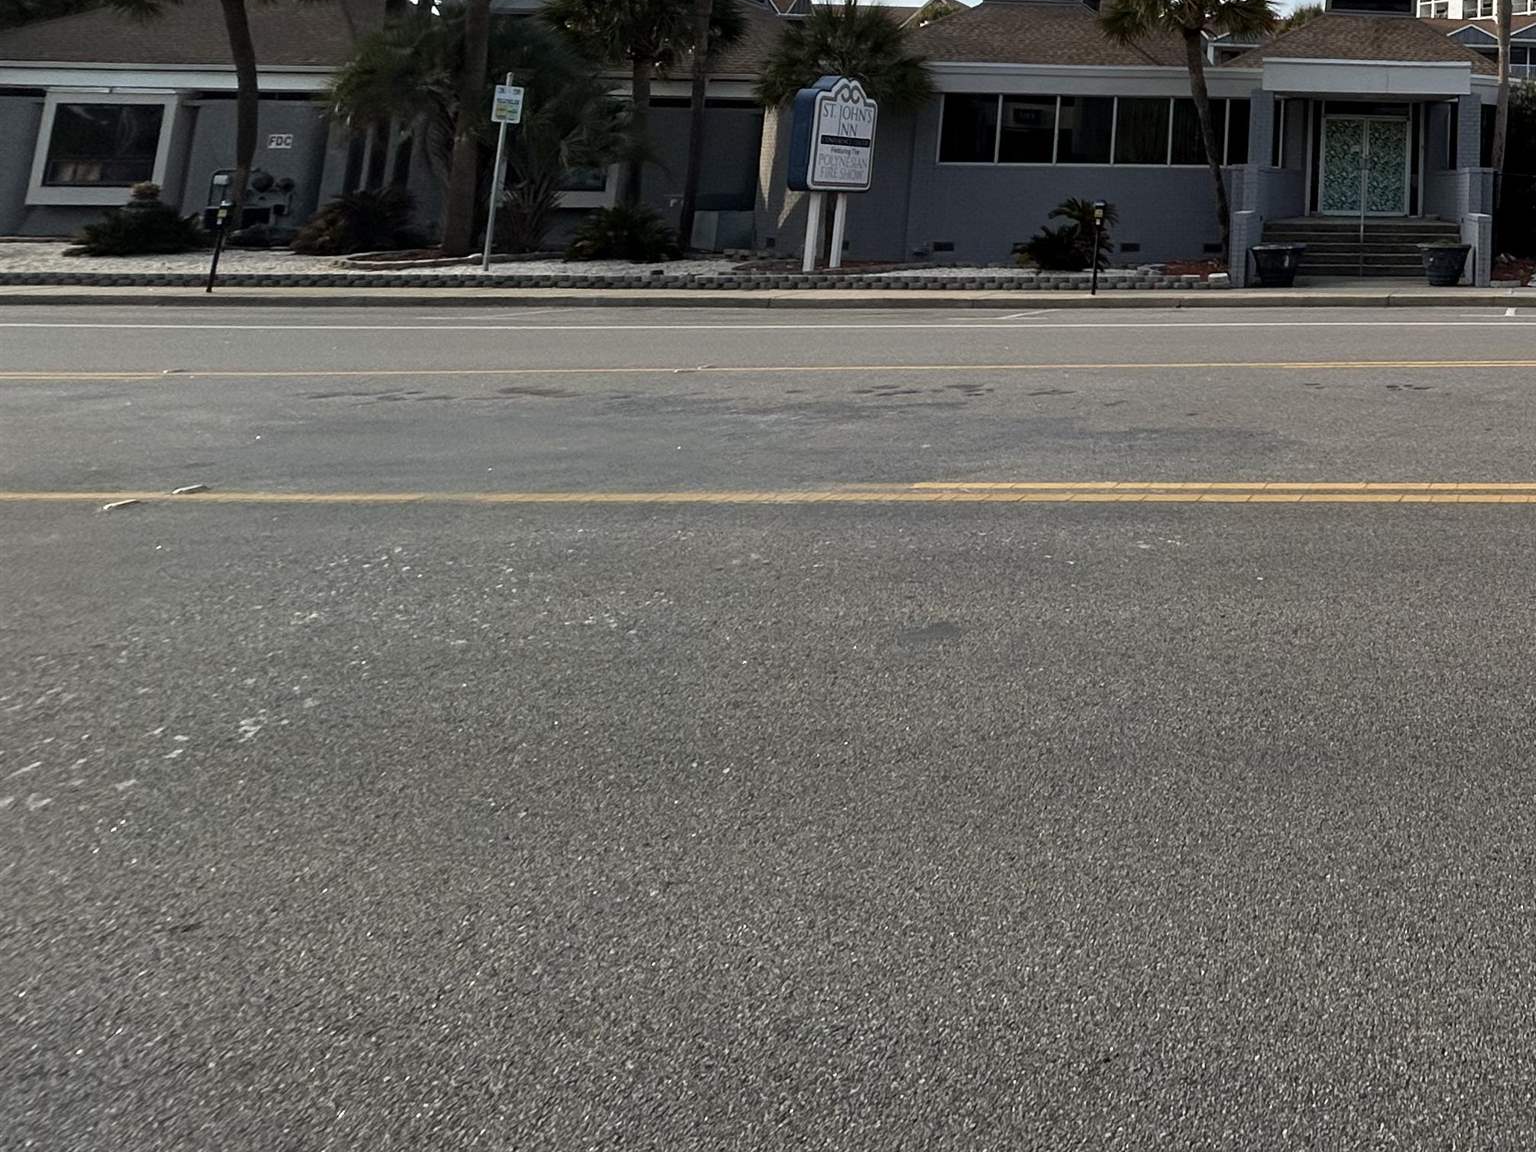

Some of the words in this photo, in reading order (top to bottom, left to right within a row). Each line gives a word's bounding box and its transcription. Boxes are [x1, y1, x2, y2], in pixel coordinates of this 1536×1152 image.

[838, 122, 858, 136] INN
[269, 136, 291, 146] FDC
[818, 153, 868, 169] POLYNESIAN
[820, 166, 837, 178] FIRE
[840, 168, 864, 180] SHOW
